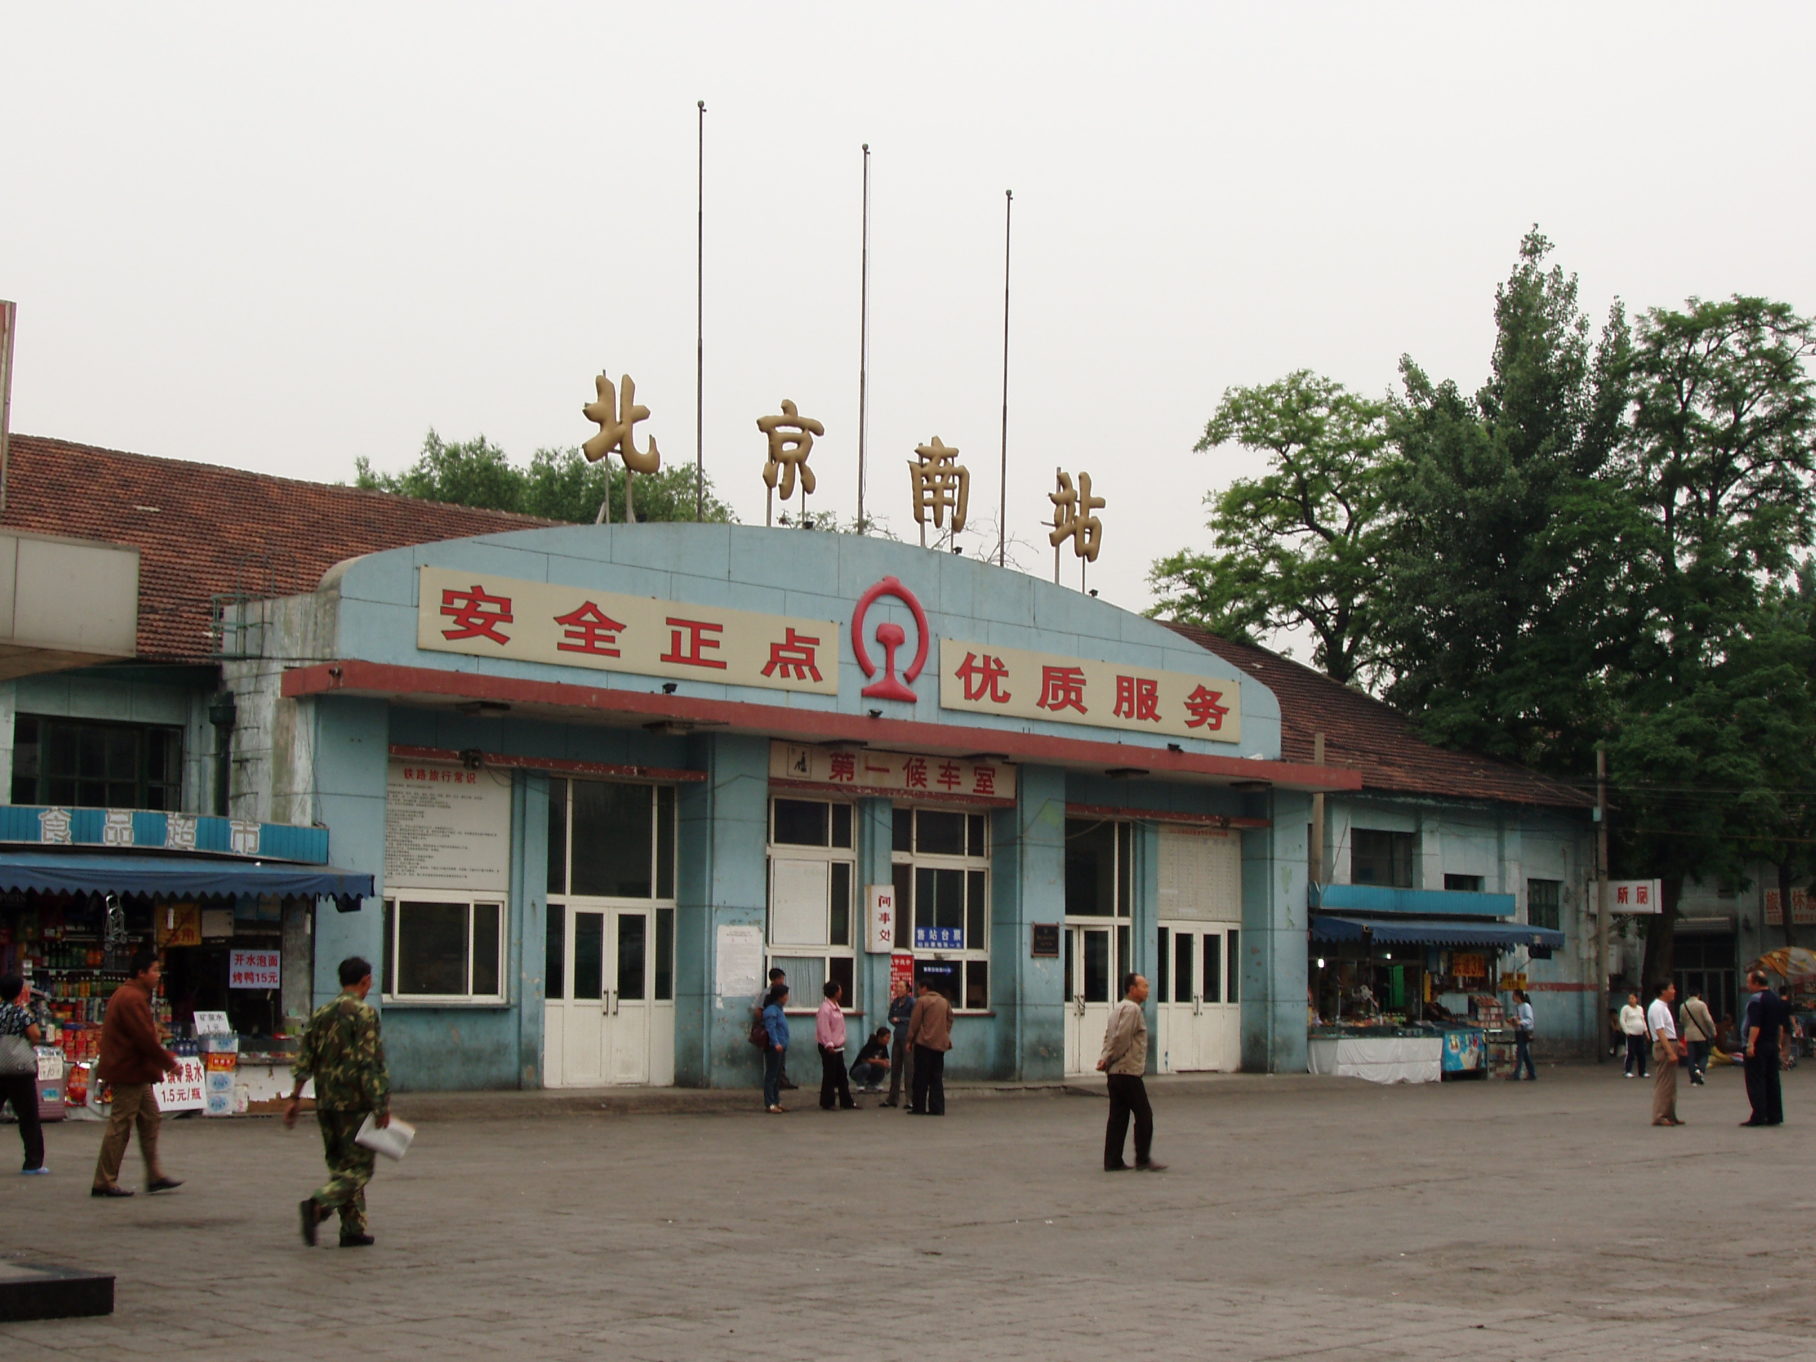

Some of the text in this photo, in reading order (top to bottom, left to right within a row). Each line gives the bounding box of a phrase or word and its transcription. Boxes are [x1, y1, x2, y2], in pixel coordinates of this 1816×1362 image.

[582, 374, 1106, 562] 北京南站
[440, 585, 823, 682] 安全正点
[955, 652, 1230, 731] 优质服务
[403, 767, 477, 785] 铁路旅行常识
[829, 752, 996, 796] 第一候车室
[38, 807, 262, 854] 食品超市
[878, 894, 892, 943] 问事处
[917, 929, 961, 941] 售站台票
[233, 971, 278, 984] 烤鸭15元
[234, 953, 278, 967] 开水泡面
